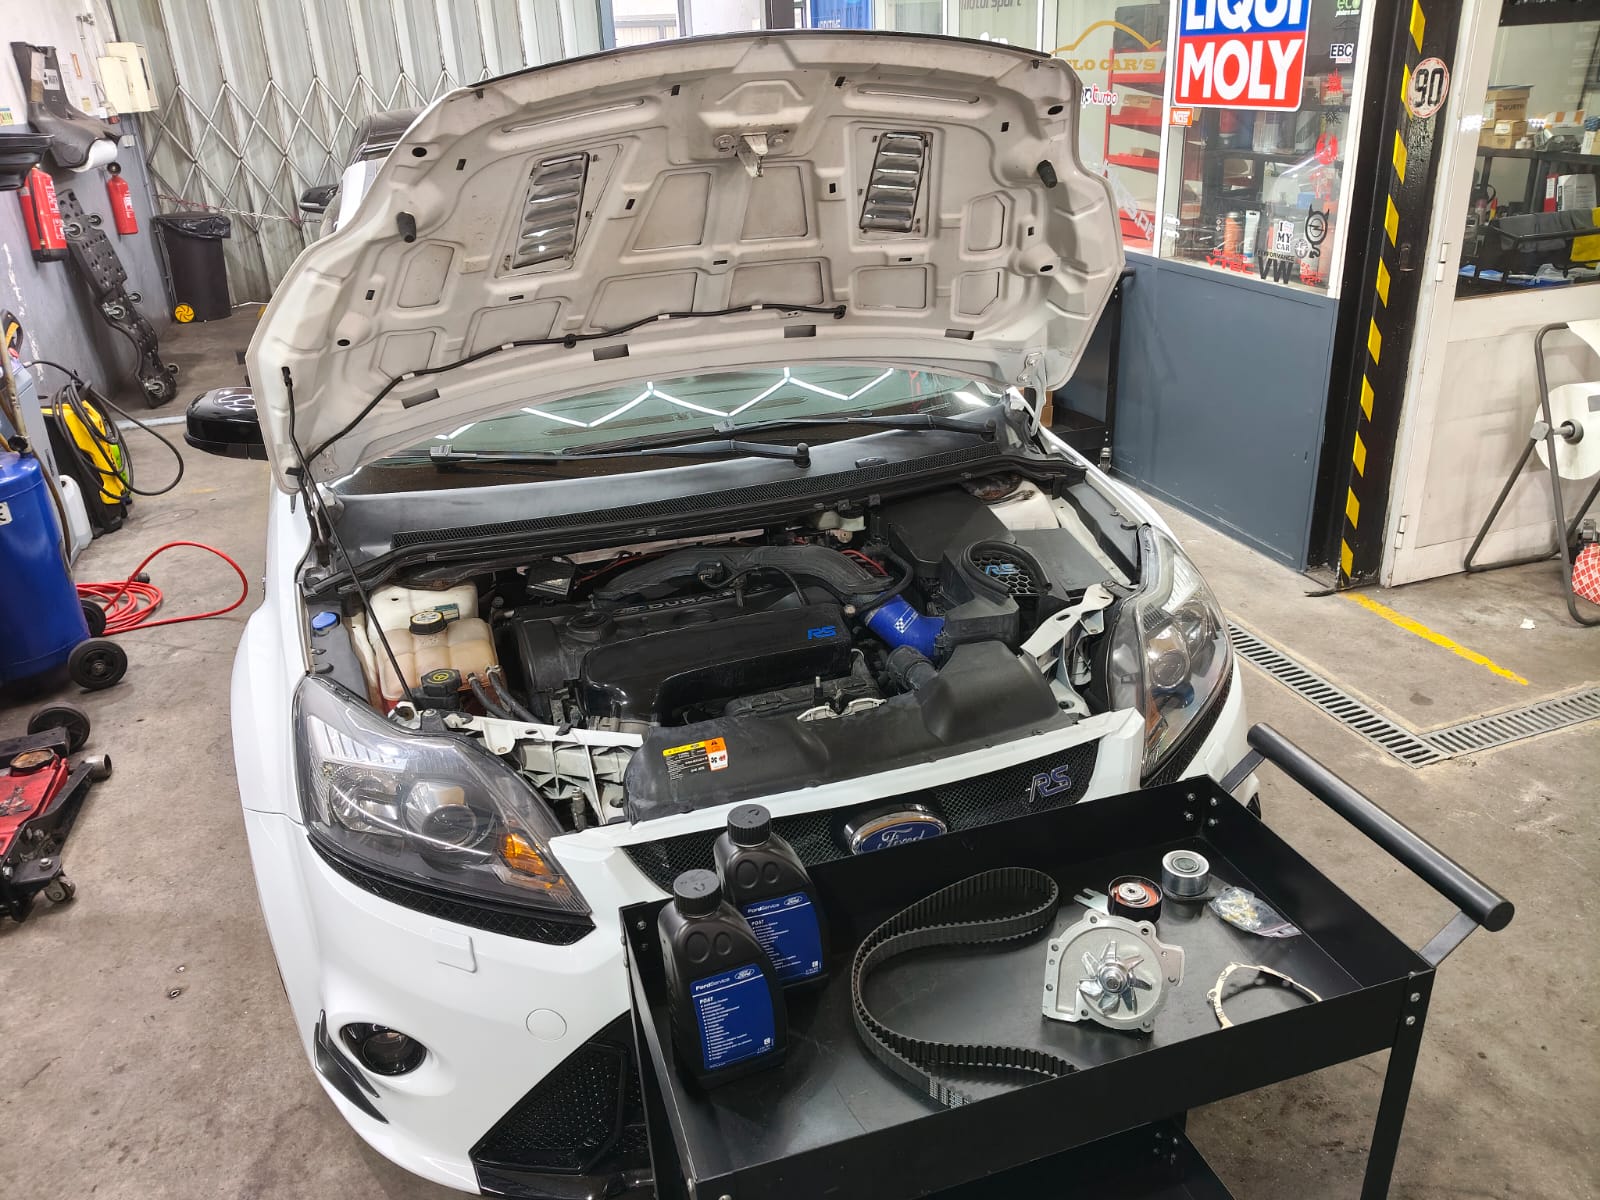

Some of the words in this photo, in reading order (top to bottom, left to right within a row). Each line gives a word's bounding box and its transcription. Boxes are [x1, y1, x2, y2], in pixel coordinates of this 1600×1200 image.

[1185, 0, 1303, 32] LIQUI
[1330, 44, 1353, 57] EBC
[1099, 59, 1156, 71] CAR'S
[1180, 39, 1303, 101] MOLY
[1413, 67, 1445, 107] 90
[1277, 232, 1293, 243] MY
[1276, 243, 1290, 252] CAR
[1206, 255, 1255, 275] VTEC
[1258, 256, 1294, 284] VW
[807, 625, 837, 641] RS
[1029, 764, 1072, 803] RS
[747, 903, 781, 914] FordService
[695, 977, 731, 991] FordService
